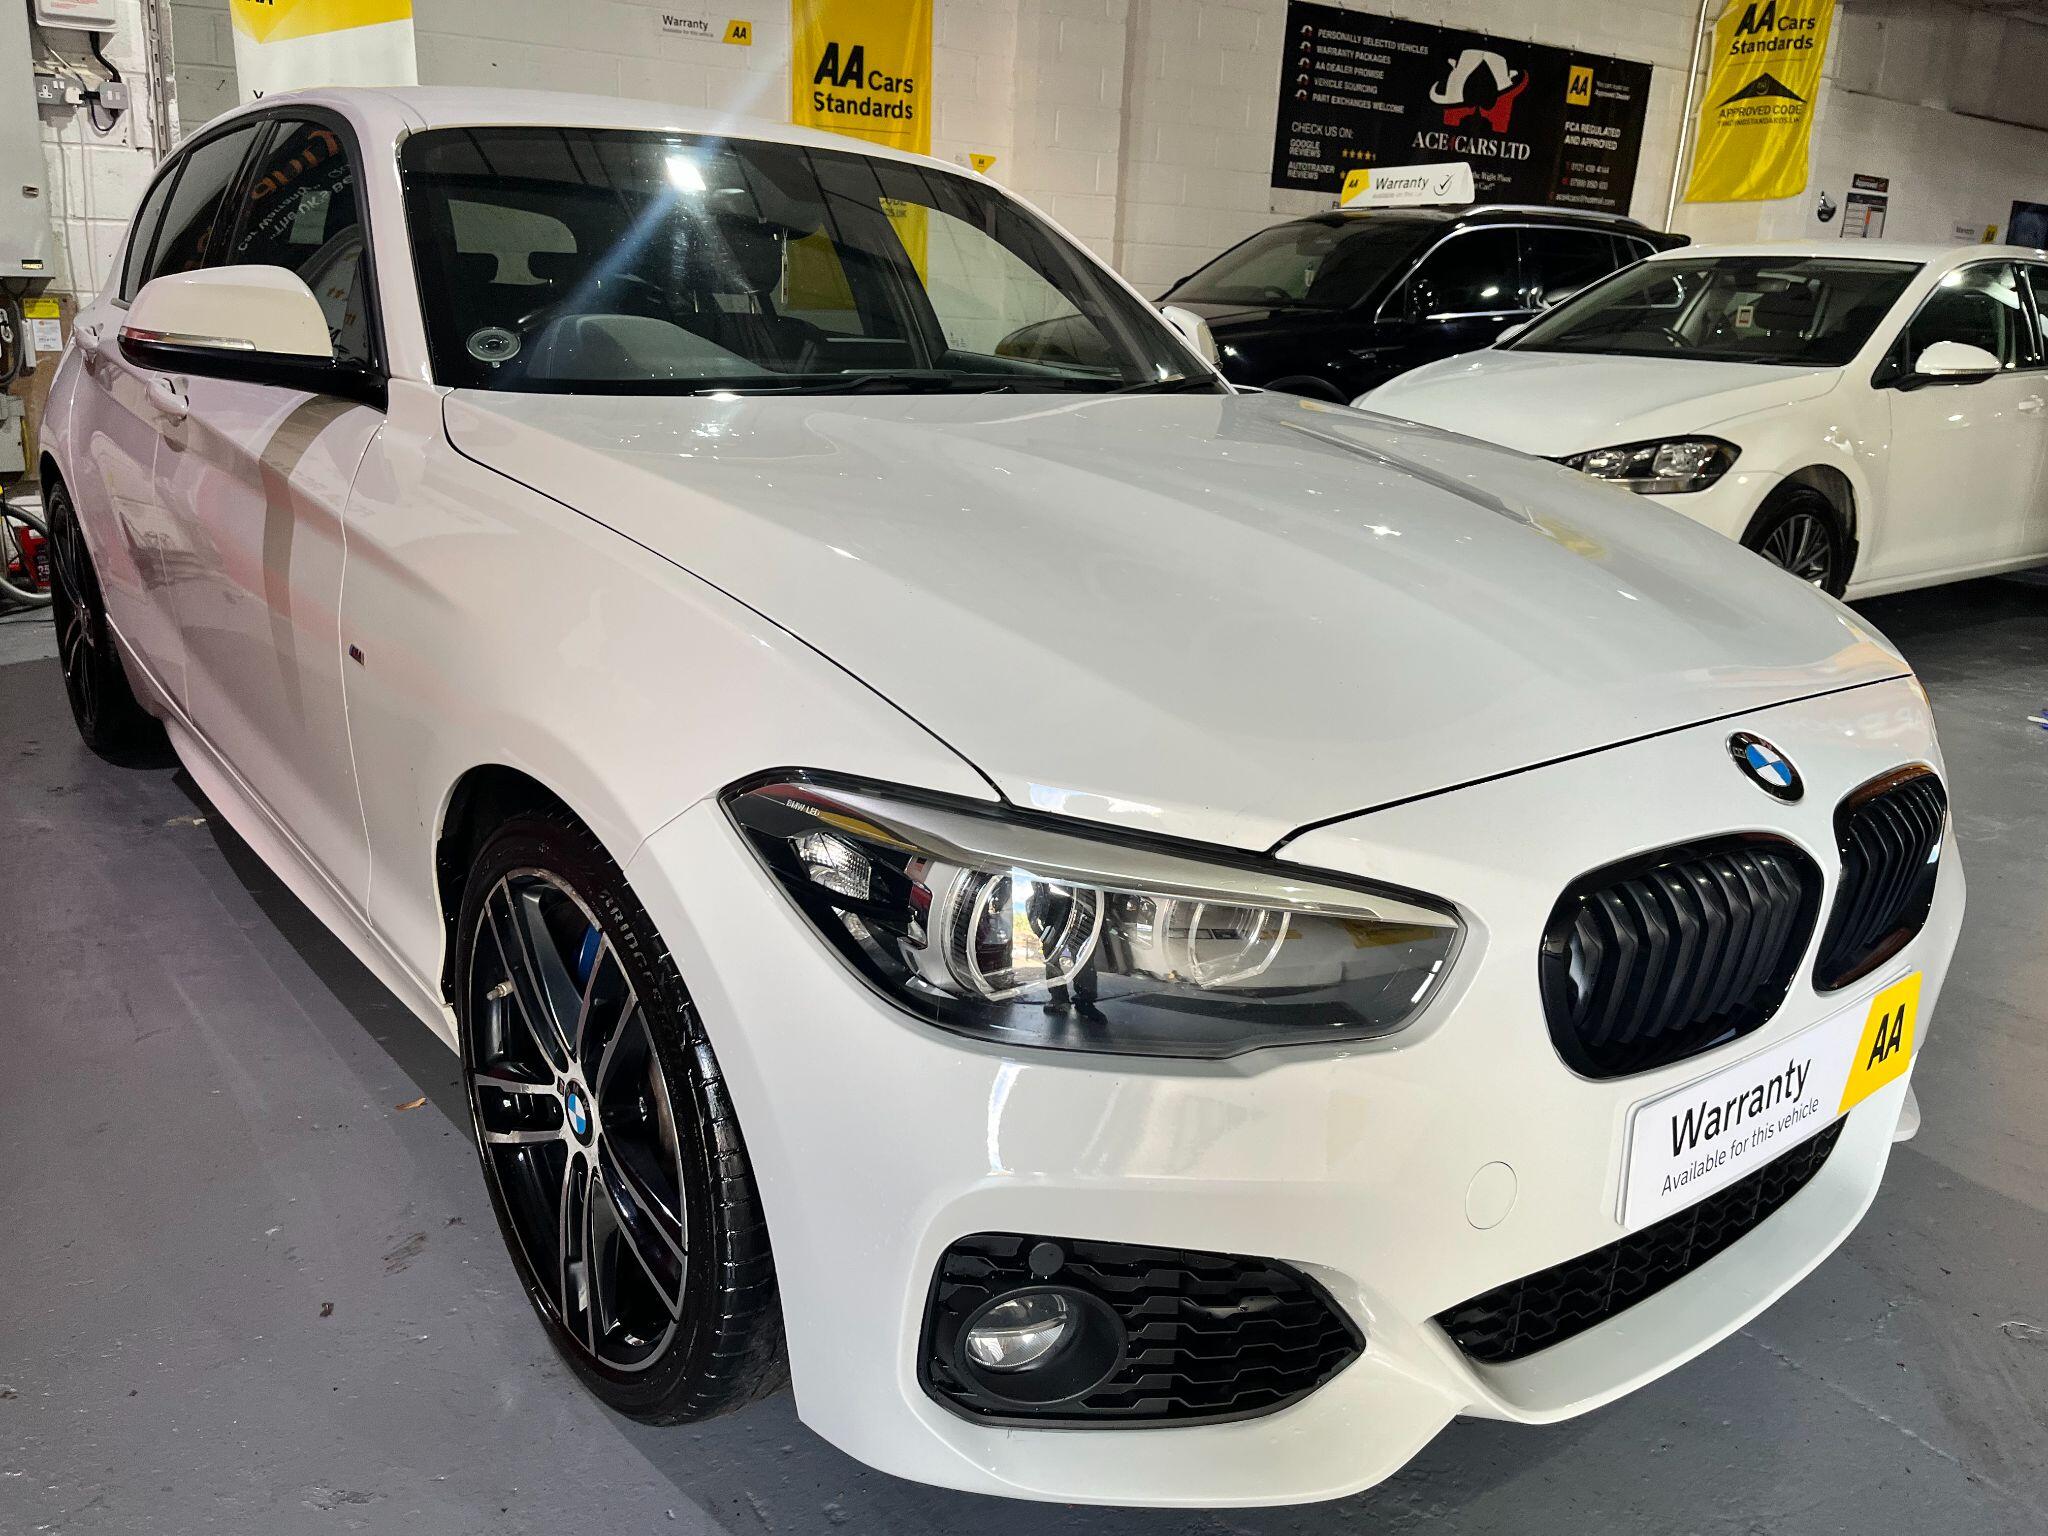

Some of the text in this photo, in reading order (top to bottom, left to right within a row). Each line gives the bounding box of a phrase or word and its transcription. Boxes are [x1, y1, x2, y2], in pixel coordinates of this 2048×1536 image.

[662, 14, 709, 31] Warranty
[1735, 0, 1815, 36] AA Cars
[732, 26, 747, 39] AA
[1317, 28, 1429, 55] PERSONALLY SELECTED VEHICLES
[1730, 35, 1814, 55] Standards
[1316, 45, 1391, 65] WARRANTY PACKAGES
[814, 42, 914, 94] AA Cars
[1326, 62, 1353, 75] DEALER
[1354, 67, 1385, 80] PROMISE
[1314, 77, 1378, 95] VEHICLE SOURCING
[1569, 74, 1589, 96] AA
[813, 91, 914, 120] Standards
[1312, 92, 1405, 114] PART EXCHANGES WELCOME
[1719, 104, 1802, 118] APPROVED CODE
[1291, 121, 1354, 139] CHECK US ON:
[1564, 121, 1622, 138] FCA REGULATED
[1289, 138, 1321, 150] GOOGLE
[1499, 141, 1531, 161] LTD
[1564, 135, 1618, 151] AND APPROVED
[1288, 147, 1321, 158] REVIEWS
[1287, 169, 1319, 180] REVIEWS
[1288, 160, 1335, 174] AUTOTRADER
[1375, 175, 1430, 191] Warranty
[786, 799, 820, 817] BMW LED
[1866, 1003, 1906, 1072] AA
[1671, 1058, 1812, 1158] Warranty
[1661, 1098, 1821, 1197] Available for this vehicle
